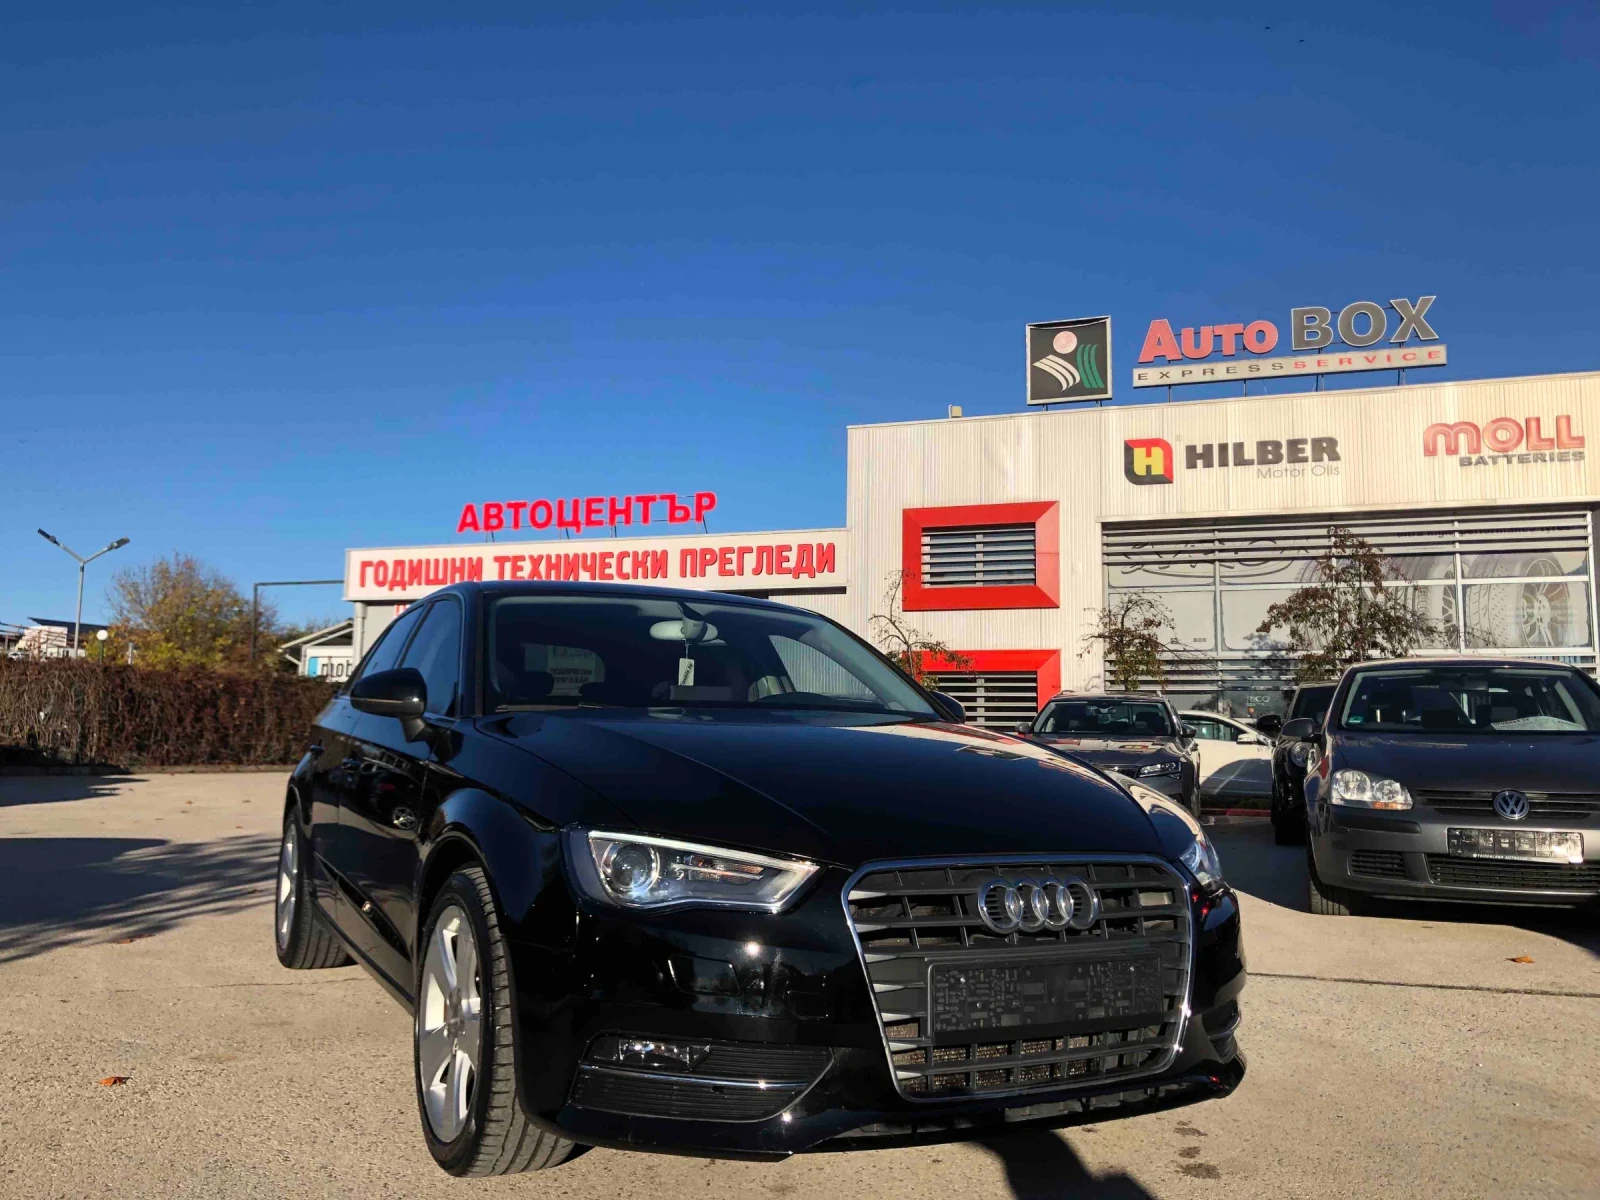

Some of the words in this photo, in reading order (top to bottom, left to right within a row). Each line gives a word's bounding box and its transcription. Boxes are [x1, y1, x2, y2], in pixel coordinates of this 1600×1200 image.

[1291, 296, 1439, 350] BOX
[1185, 437, 1341, 469] HILBER
[1256, 466, 1306, 479] Motor
[1311, 464, 1340, 477] Oils
[1459, 450, 1586, 467] BATTERIES
[457, 491, 717, 534] АВТОЦЕНТЪР
[360, 556, 483, 591] ГОДИШНИ
[493, 549, 668, 581] ТЕХНИЧЕСКИ
[679, 542, 835, 579] ПРЕГЛЕДИ
